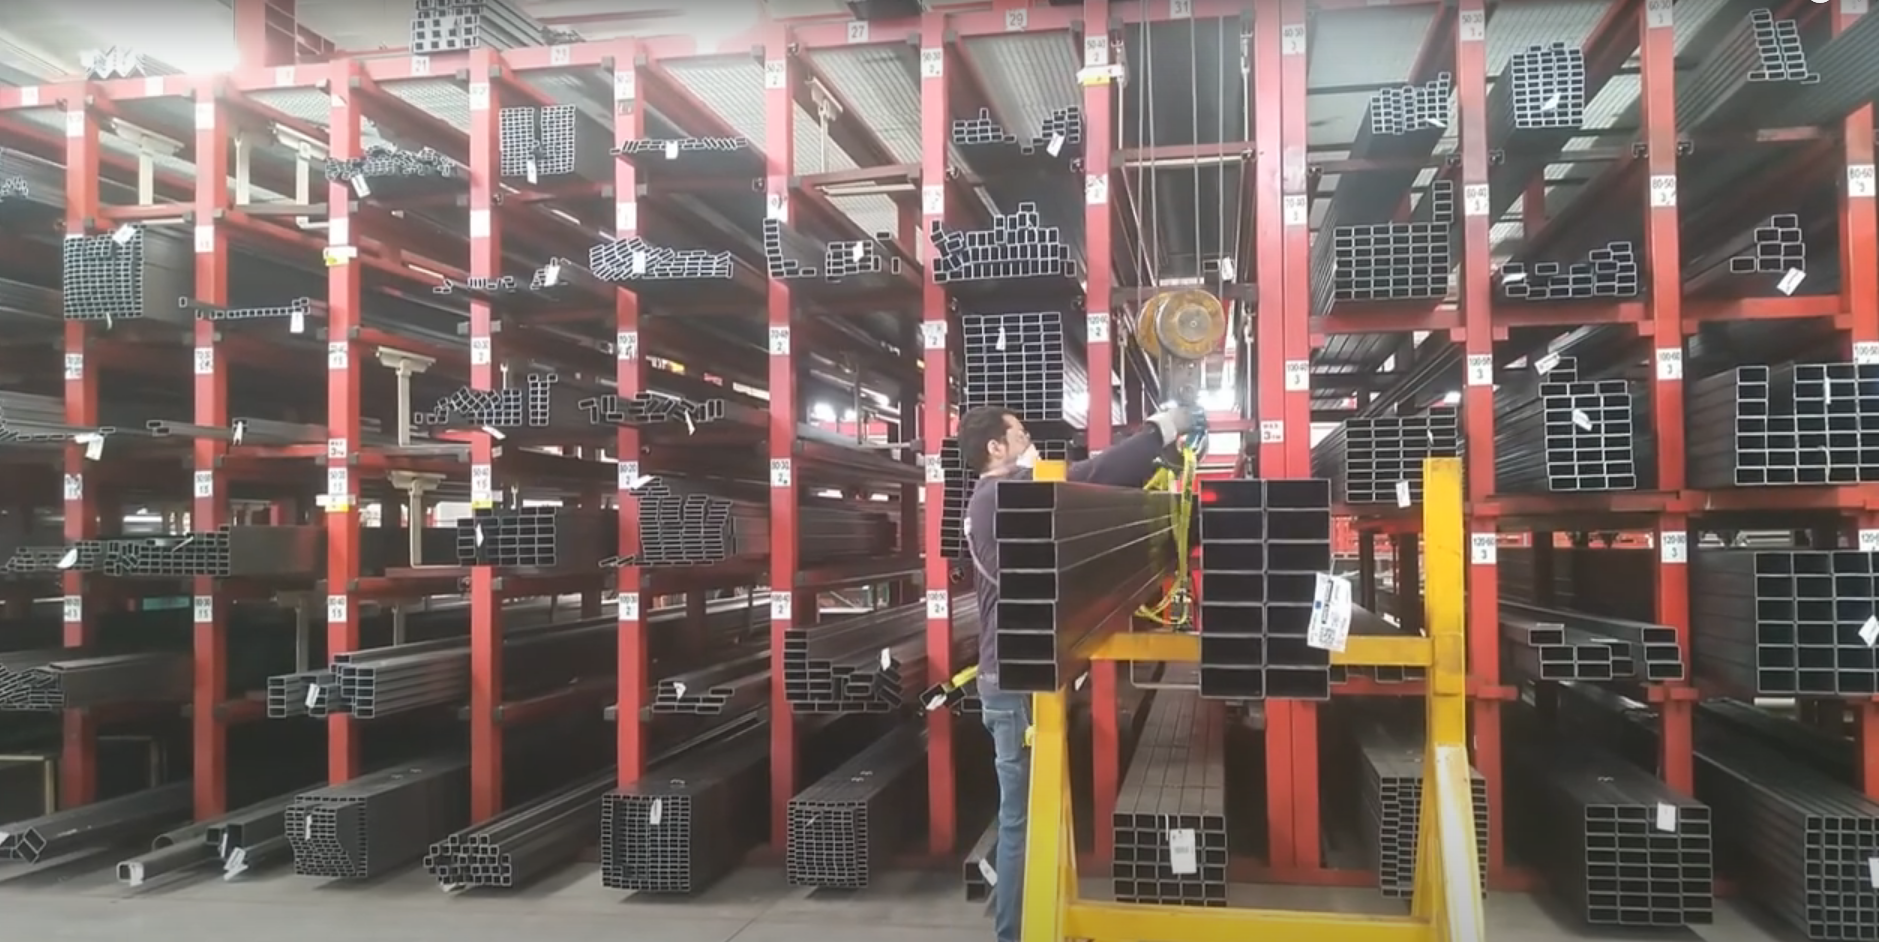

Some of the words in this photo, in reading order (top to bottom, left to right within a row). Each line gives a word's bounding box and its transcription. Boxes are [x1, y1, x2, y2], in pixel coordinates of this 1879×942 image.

[1174, 1, 1189, 14] 31
[1009, 12, 1024, 26] 29
[850, 25, 864, 38] 27
[1661, 192, 1667, 202] 3
[1096, 326, 1102, 337] 2
[777, 341, 783, 351] 2
[1477, 368, 1484, 379] 3
[1666, 364, 1673, 374] 3
[1294, 374, 1301, 385] 3
[625, 475, 631, 485] 2
[778, 473, 784, 483] 2
[1481, 549, 1487, 560] 3
[1671, 547, 1677, 558] 3
[625, 606, 632, 616] 2
[778, 604, 784, 614] 2
[934, 603, 940, 613] 2
